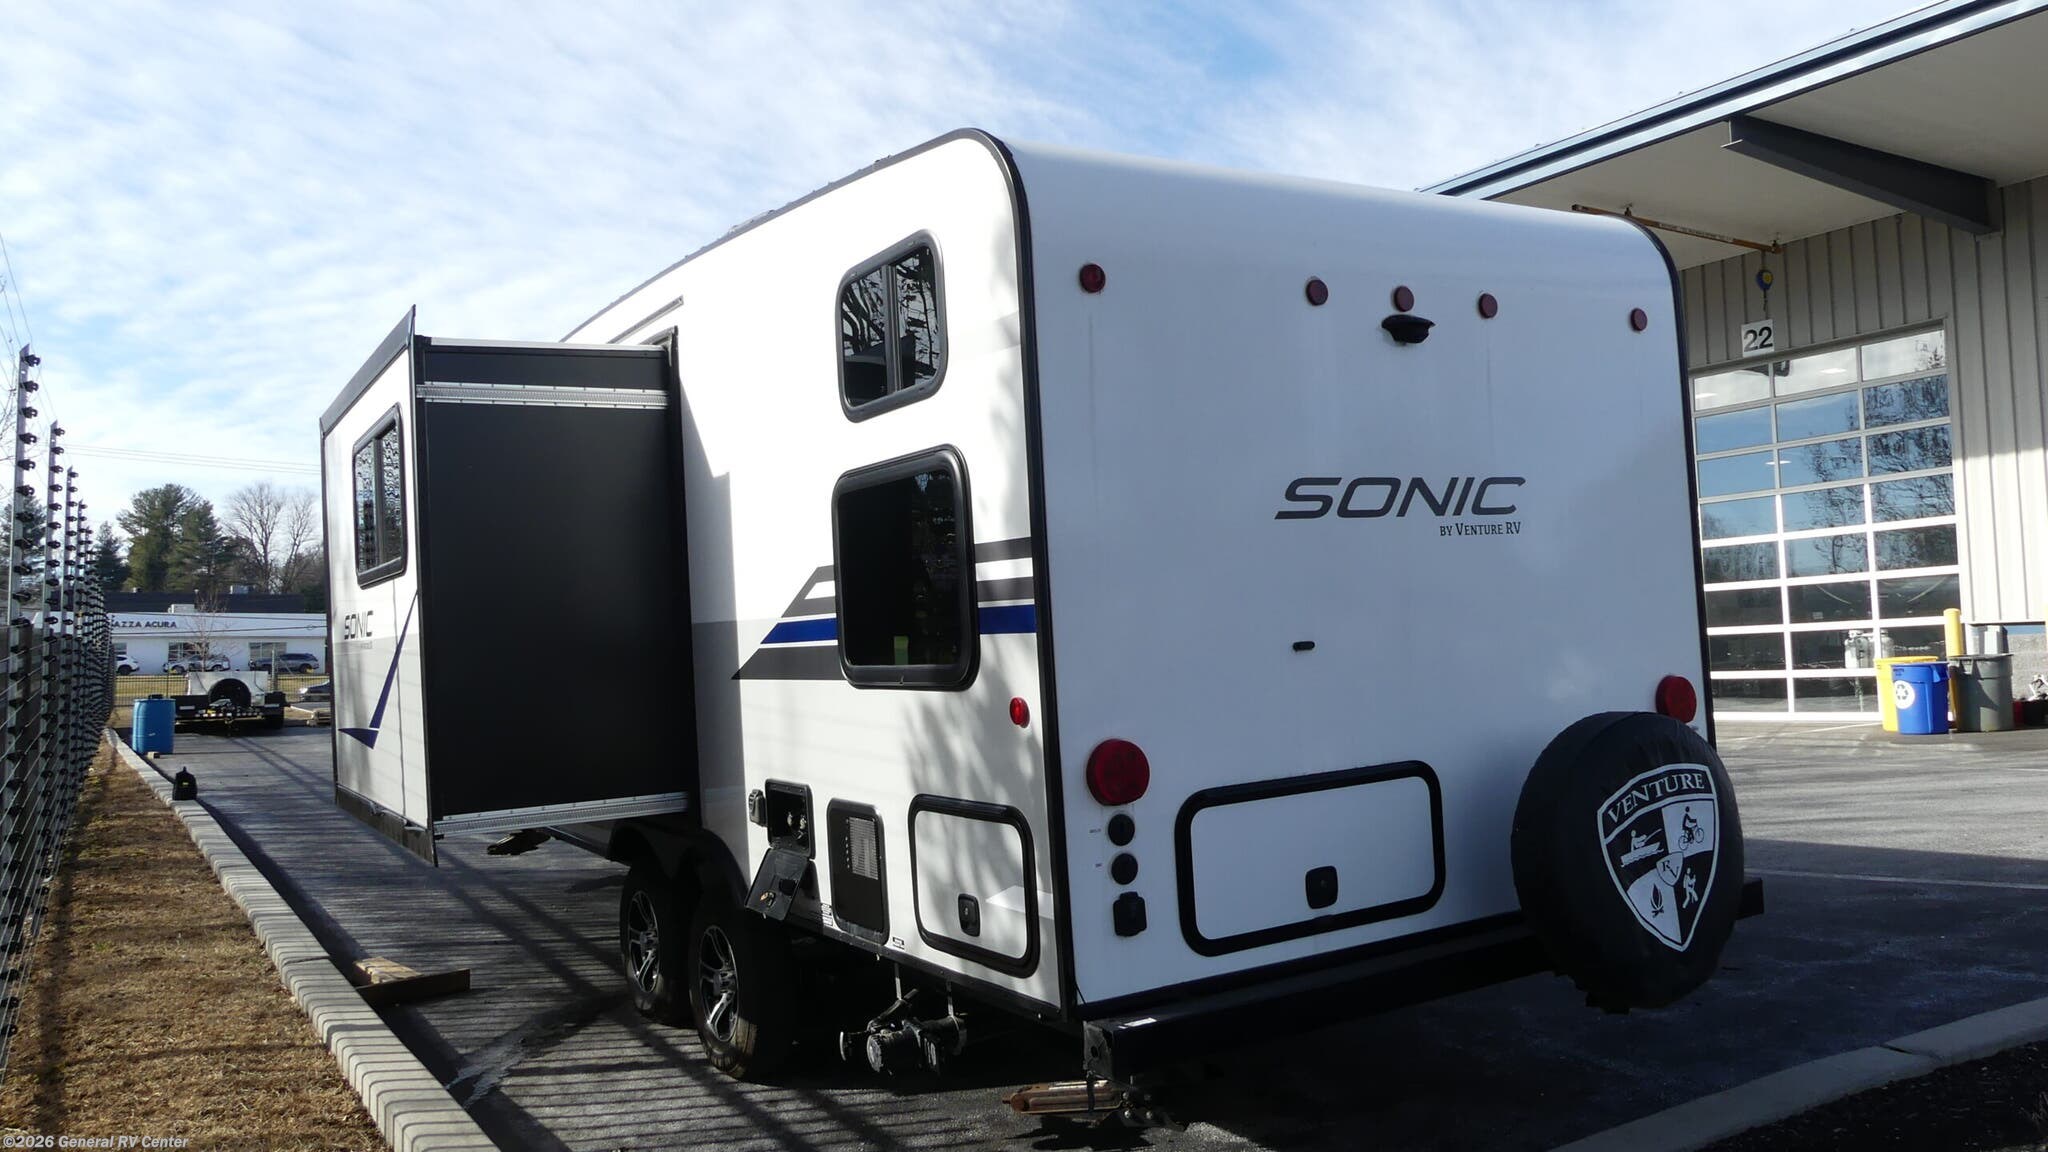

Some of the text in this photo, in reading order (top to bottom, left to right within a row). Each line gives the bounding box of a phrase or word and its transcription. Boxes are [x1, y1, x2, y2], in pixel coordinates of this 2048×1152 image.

[1743, 326, 1773, 352] 22
[1274, 476, 1526, 519] SONIC
[1440, 525, 1453, 536] BY
[1506, 521, 1522, 535] RV
[344, 610, 374, 640] SONIC
[1607, 772, 1705, 823] VENTURE
